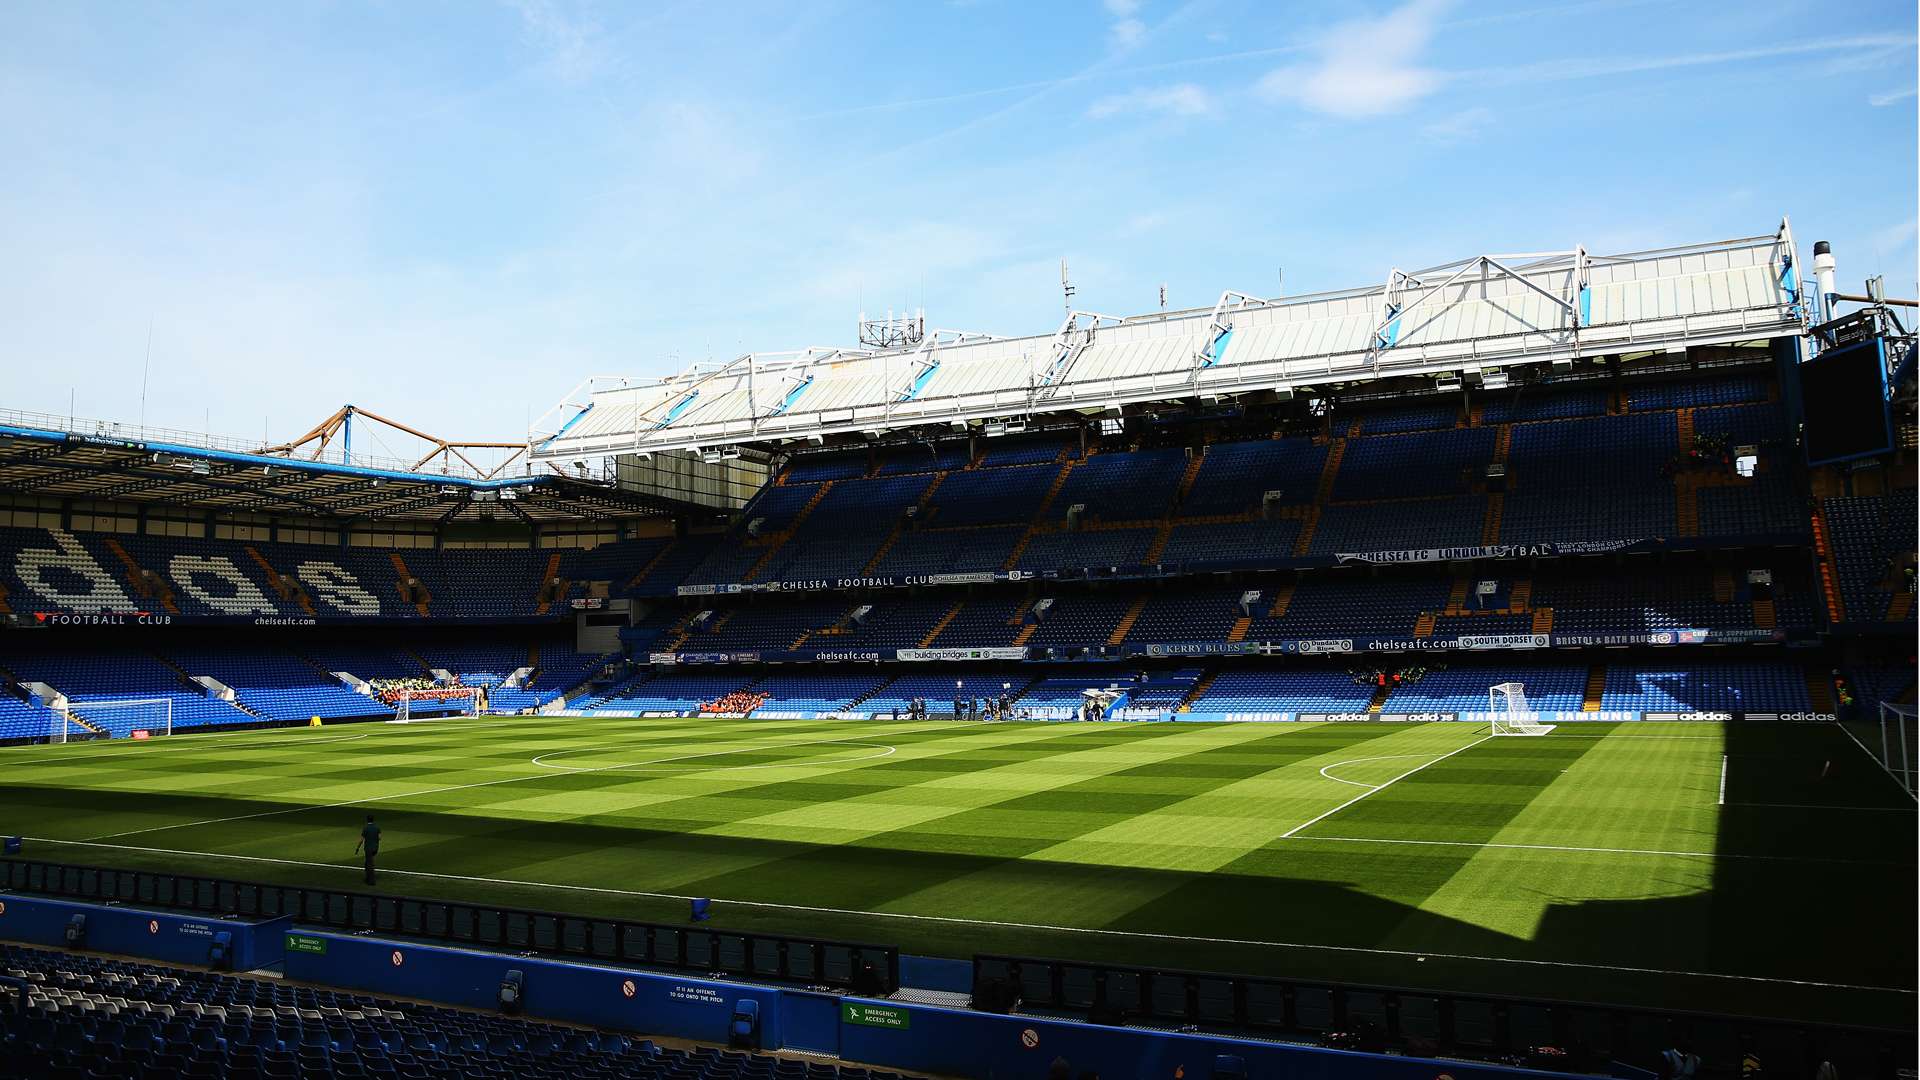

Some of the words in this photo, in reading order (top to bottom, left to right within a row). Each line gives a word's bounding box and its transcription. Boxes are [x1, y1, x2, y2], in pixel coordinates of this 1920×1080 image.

[1359, 551, 1410, 562] CHELSEA
[1414, 550, 1428, 560] FC
[1439, 548, 1486, 558] LONDON
[782, 580, 828, 590] CHELSEA
[838, 577, 894, 588] FOOTBALL
[905, 576, 934, 585] CLUB
[52, 615, 125, 625] FOOTBALL
[138, 615, 171, 625] CLUB
[254, 616, 316, 626] chelseafc.com
[1369, 638, 1459, 650] chelseafc.com
[1474, 636, 1500, 645] SOUTH
[1502, 636, 1532, 644] DORSET
[1556, 636, 1592, 645] BRISTOL
[1596, 637, 1602, 645] &
[1604, 636, 1628, 644] BATH
[1630, 634, 1657, 644] BLUES
[1166, 644, 1203, 654] KERRY
[1206, 644, 1240, 653] BLUES
[816, 651, 879, 661] chelseafc.com
[914, 650, 940, 660] building
[942, 650, 968, 660] bridges
[1225, 712, 1288, 721] SAMSUNG
[1327, 714, 1370, 722] adidas
[1555, 712, 1632, 721] SAMSUNG
[1679, 712, 1732, 720] adidas
[1780, 712, 1836, 720] adidas
[864, 1009, 898, 1018] EMERGENCY
